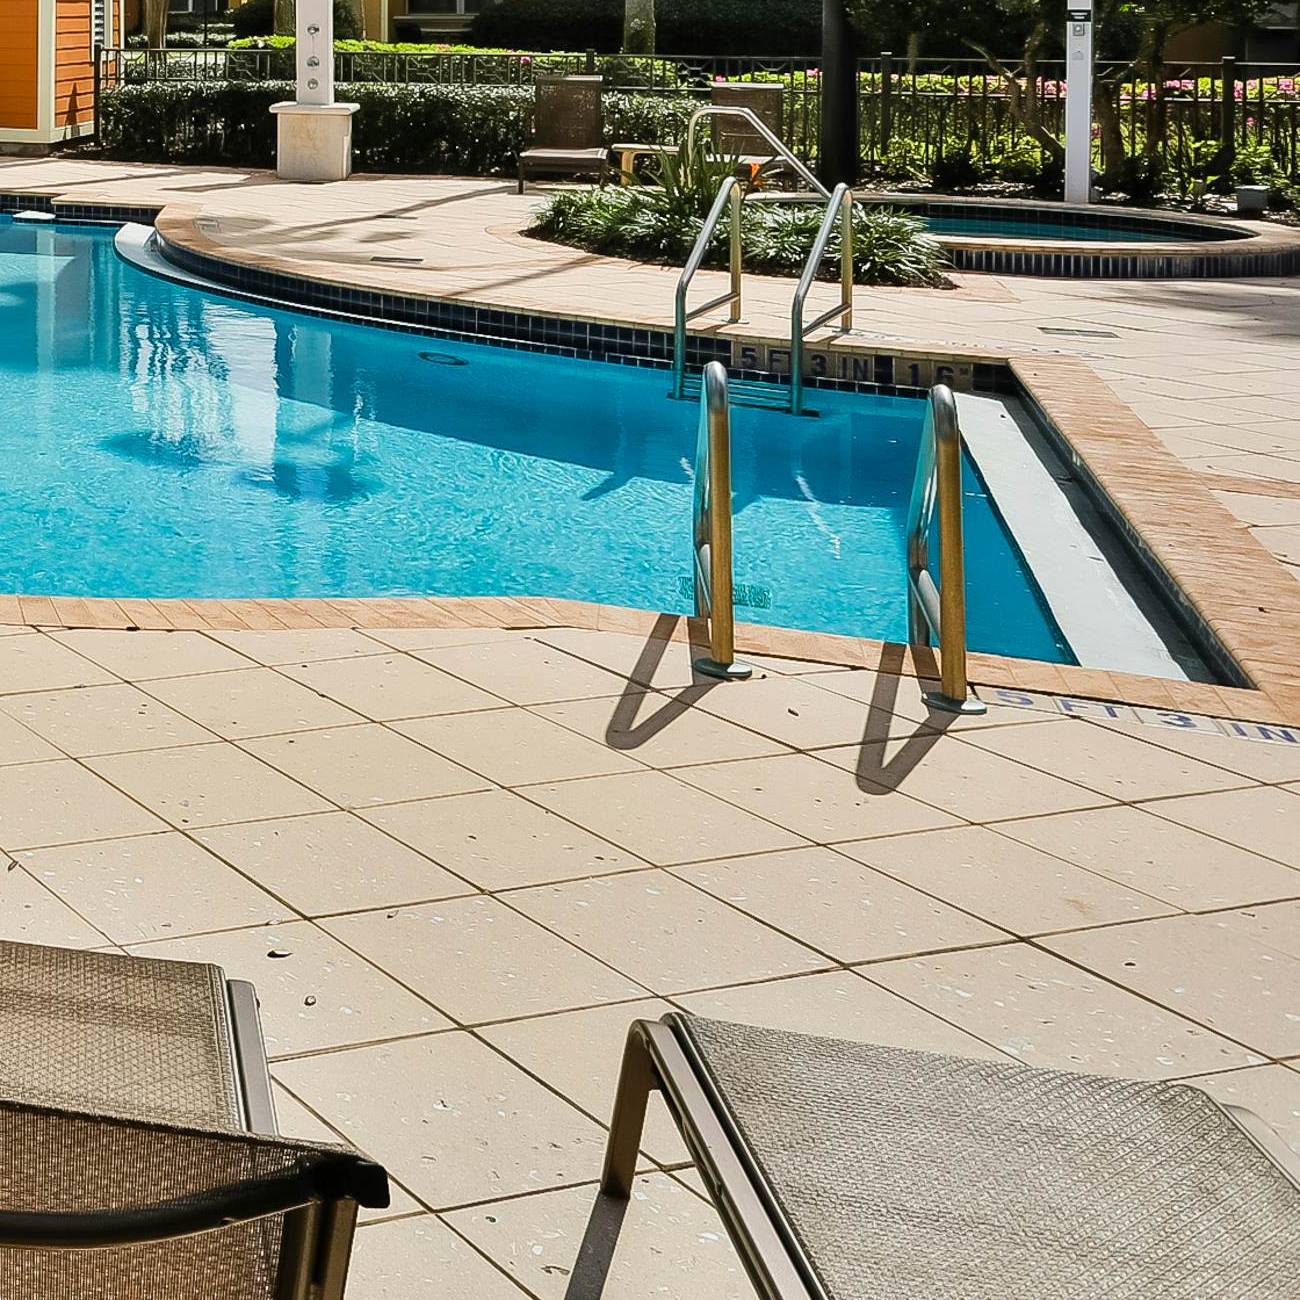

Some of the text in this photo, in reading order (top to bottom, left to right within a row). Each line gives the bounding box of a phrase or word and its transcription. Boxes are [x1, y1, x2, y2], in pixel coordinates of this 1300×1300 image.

[741, 346, 757, 369] 5
[811, 353, 827, 377] 3
[840, 356, 869, 381] IN
[995, 689, 1299, 744] 5 FT 3 IN
